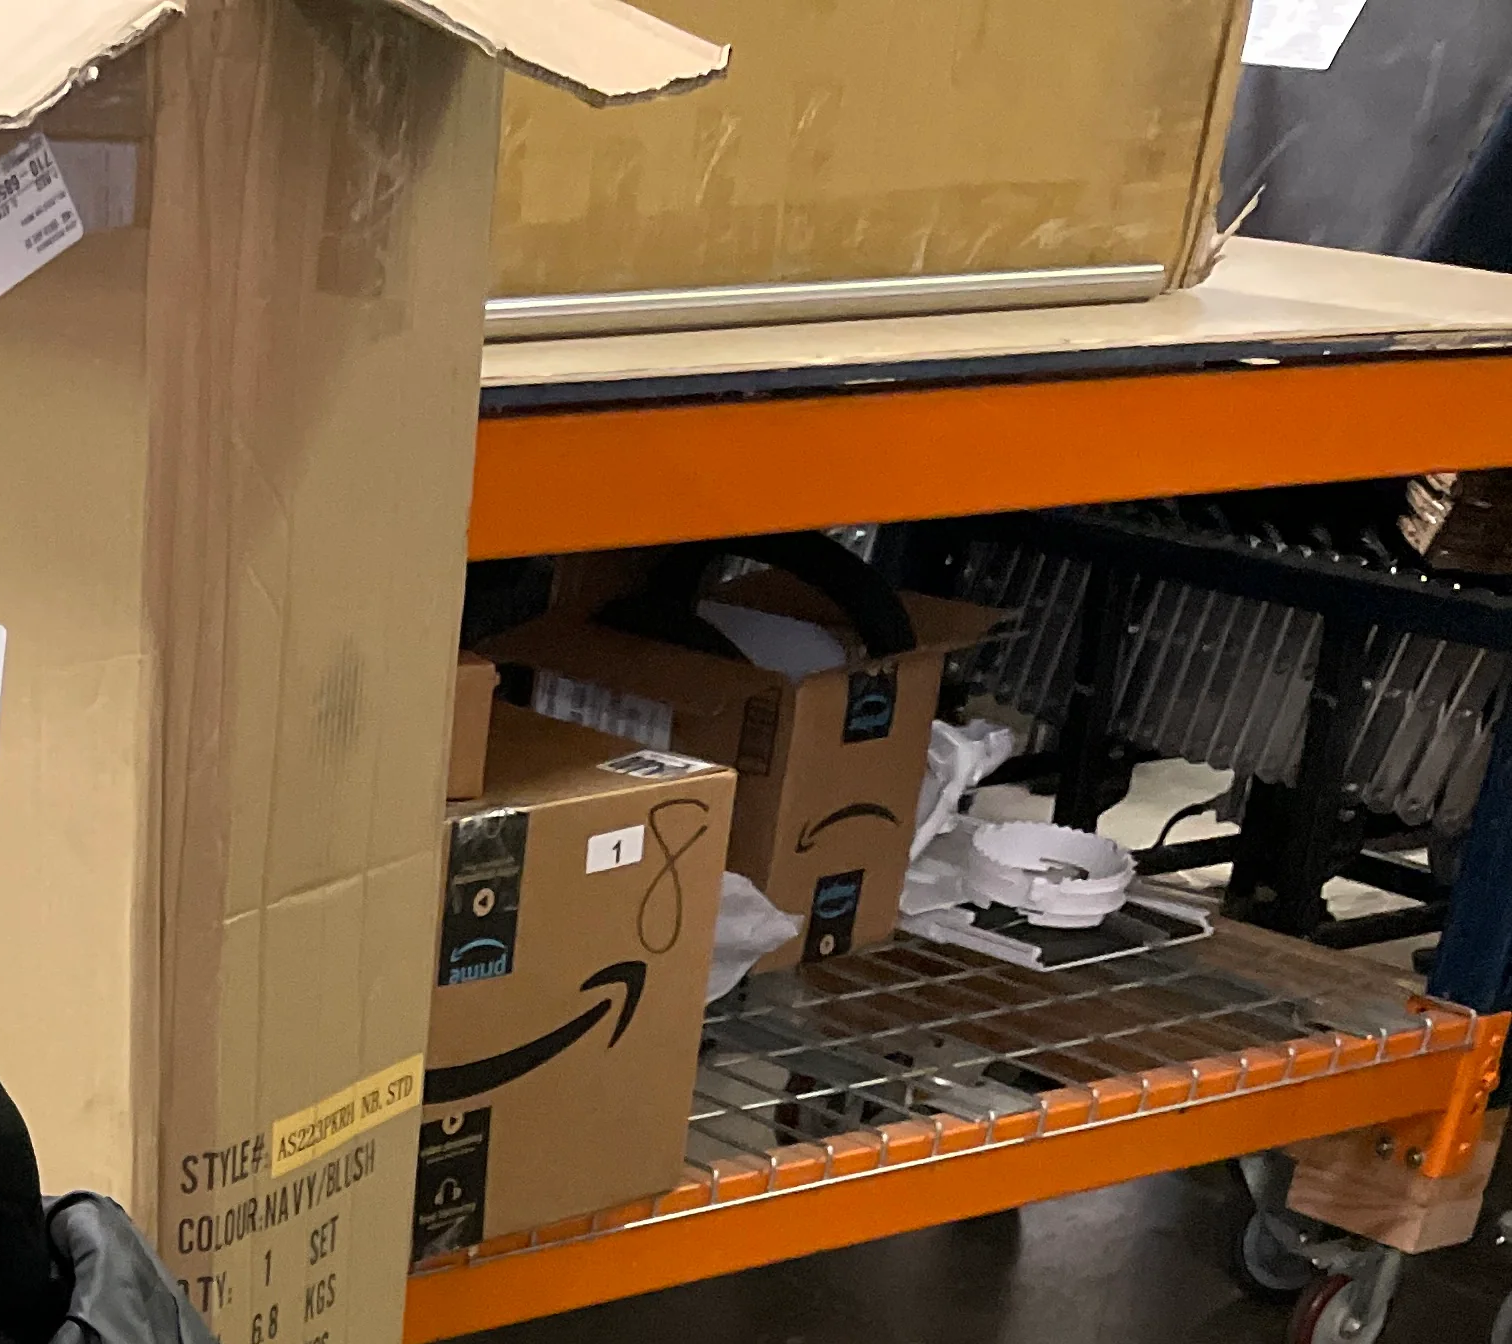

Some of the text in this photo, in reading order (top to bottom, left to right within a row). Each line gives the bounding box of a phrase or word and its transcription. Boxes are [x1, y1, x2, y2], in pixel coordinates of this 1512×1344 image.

[612, 840, 622, 864] 1
[386, 1074, 414, 1106] STD
[264, 1249, 273, 1287] 1
[309, 1214, 340, 1266] SET
[303, 1272, 337, 1324] KGS
